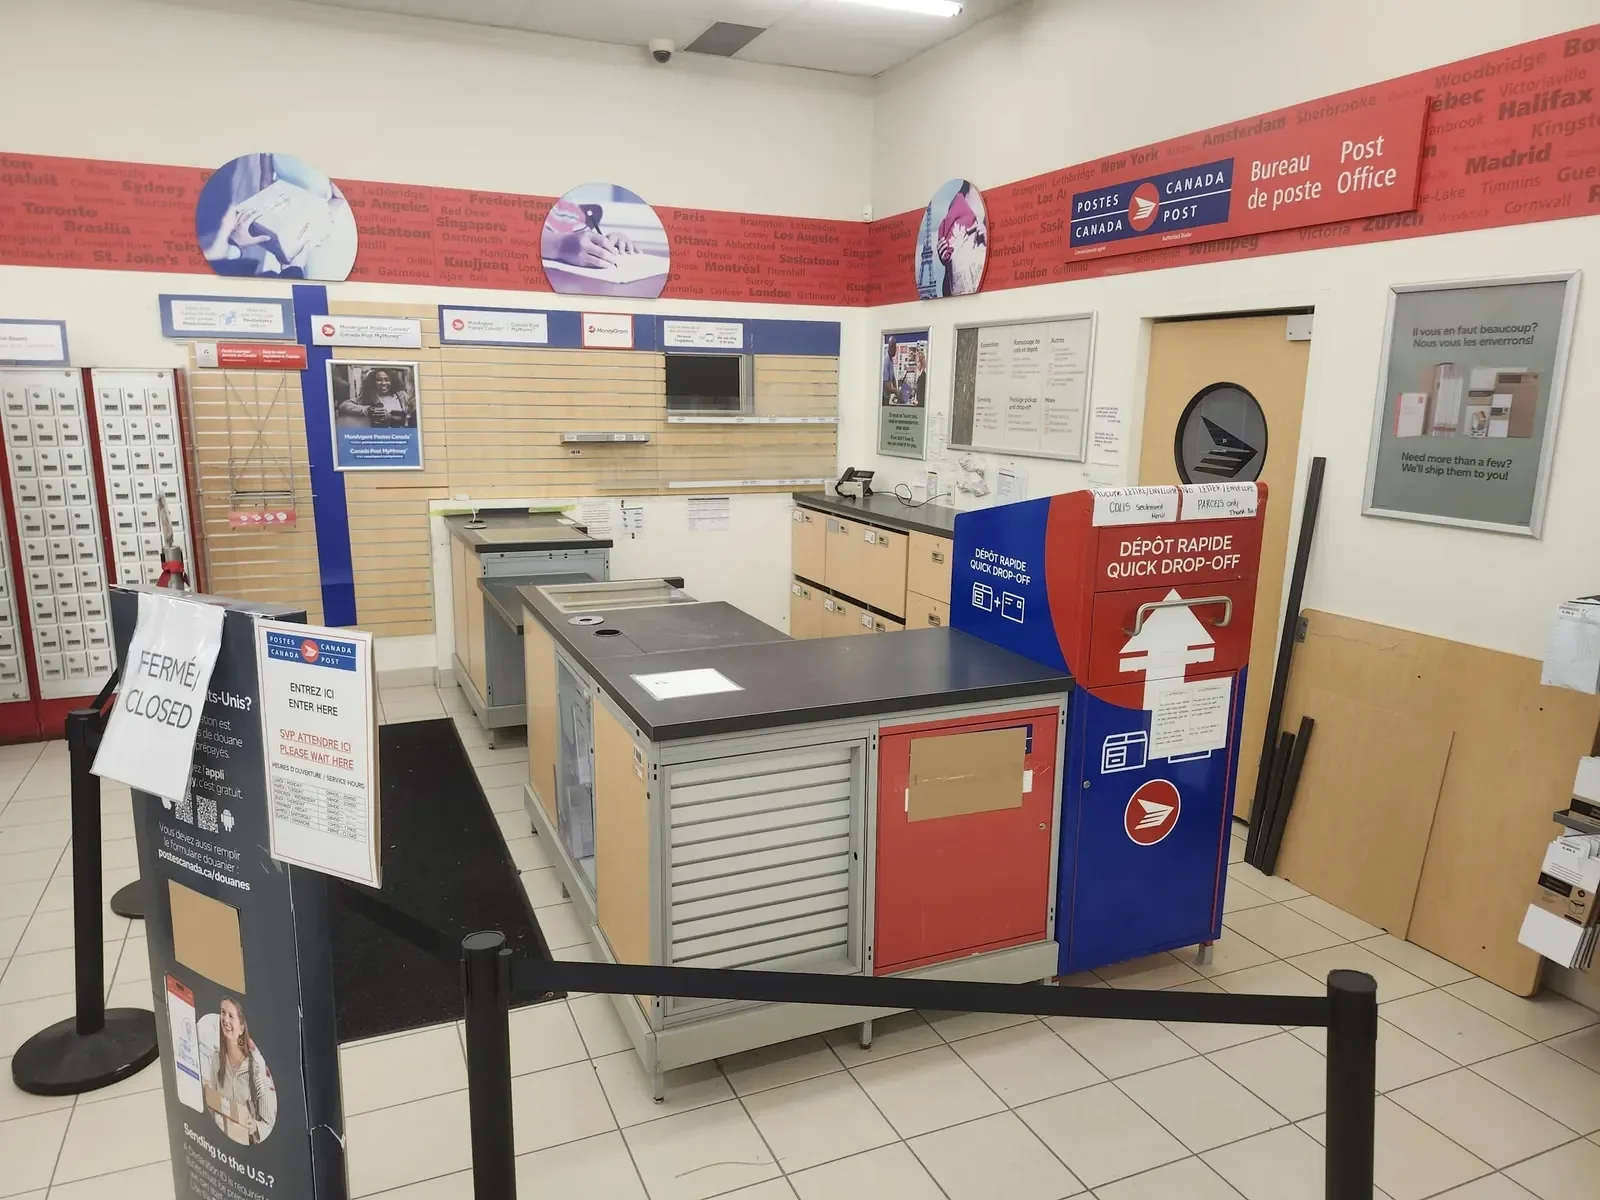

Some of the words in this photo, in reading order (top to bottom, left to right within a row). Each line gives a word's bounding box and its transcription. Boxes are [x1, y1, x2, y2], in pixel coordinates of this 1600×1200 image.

[1434, 51, 1547, 90] Woodbridge
[1498, 66, 1587, 98] Victoriaville
[1296, 95, 1377, 124] Sherbrooke
[1429, 87, 1486, 113] ébec
[1498, 87, 1595, 121] Halifax
[1202, 116, 1286, 148] Amsterdam
[1340, 135, 1385, 164] Post
[1464, 142, 1553, 176] Madrid
[1101, 158, 1127, 175] New
[1130, 148, 1160, 168] York
[1250, 154, 1311, 183] Bureau
[122, 180, 186, 198] Sydney
[1165, 170, 1225, 195] CANADA
[1336, 165, 1398, 195] Office
[1481, 174, 1541, 196] Timmins
[371, 199, 430, 213] Angeles
[1077, 194, 1119, 214] POSTES
[1247, 188, 1268, 211] de
[1272, 181, 1322, 212] poste
[1503, 192, 1571, 215] Cornwall
[22, 202, 98, 218] Toronto
[673, 211, 706, 223] Paris
[1163, 204, 1198, 223] POST
[63, 220, 132, 236] Brasilia
[436, 217, 508, 232] Singapore
[1075, 219, 1122, 239] CANADA
[673, 234, 718, 248] Ottawa
[774, 231, 794, 241] Los
[797, 232, 840, 245] Angeles
[93, 250, 119, 263] St.
[125, 252, 180, 266] John's
[779, 254, 840, 267] Saskatoon
[704, 262, 760, 275] Montréal
[1014, 268, 1048, 281] London
[749, 288, 791, 299] London
[596, 326, 629, 336] MoneyGram
[1412, 327, 1420, 337] Il
[1420, 327, 1441, 336] vous
[1443, 327, 1456, 336] en
[1457, 325, 1478, 335] faut
[1479, 322, 1539, 334] beaucoup?
[1413, 338, 1438, 348] Nous
[1439, 338, 1461, 348] vous
[1463, 337, 1477, 347] les
[1479, 335, 1535, 346] enverrons!
[1401, 451, 1426, 462] Need
[1427, 454, 1452, 464] more
[1454, 456, 1476, 465] than
[1486, 457, 1513, 469] few?
[1401, 463, 1424, 474] We'll
[1424, 464, 1445, 476] ship
[1446, 466, 1472, 477] them
[1474, 469, 1485, 479] to
[1486, 471, 1509, 482] you!
[1109, 501, 1132, 513] COLIS
[1226, 499, 1239, 509] only
[1119, 537, 1175, 557] DÉPÔT
[1177, 535, 1232, 554] RAPIDE
[975, 547, 1000, 564] DÉPÔT
[999, 556, 1027, 573] RAPIDE
[1107, 559, 1157, 579] QUICK
[1161, 553, 1241, 575] DROP-OFF
[969, 559, 993, 576] QUICK
[992, 565, 1031, 586] DROP-OFF
[269, 635, 296, 646] POSTES
[320, 643, 352, 654] CANADA
[270, 648, 300, 659] CANADA
[321, 656, 340, 665] POST
[208, 689, 252, 711] ts-Unis?
[290, 682, 322, 697] ENTREZ
[324, 689, 335, 699] ICI
[125, 688, 194, 730] CLOSED
[288, 698, 314, 712] ENTER
[316, 704, 338, 717] HERE
[219, 720, 231, 731] est
[203, 730, 213, 740] de
[213, 732, 243, 748] douane
[279, 728, 295, 740] SVP
[297, 732, 339, 750] ATTENDRE
[340, 741, 352, 752] ICI
[279, 744, 309, 760] PLEASE
[310, 751, 330, 764] WAIT
[332, 757, 355, 770] HERE
[271, 762, 290, 772] HEURES
[326, 774, 346, 786] SERVICE
[347, 779, 365, 790] HOURS
[215, 784, 244, 799] gratuit.
[158, 820, 175, 837] Vous
[175, 829, 195, 846] devez
[195, 838, 213, 852] aussi
[213, 844, 241, 861] remplir
[163, 836, 170, 848] le
[170, 839, 202, 861] formulaire
[202, 853, 235, 873] douanier
[158, 848, 251, 891] postescanada.ca/douanes
[183, 1122, 217, 1159] Sending
[216, 1148, 228, 1164] to
[228, 1155, 246, 1175] the
[246, 1164, 276, 1189] U.S.?
